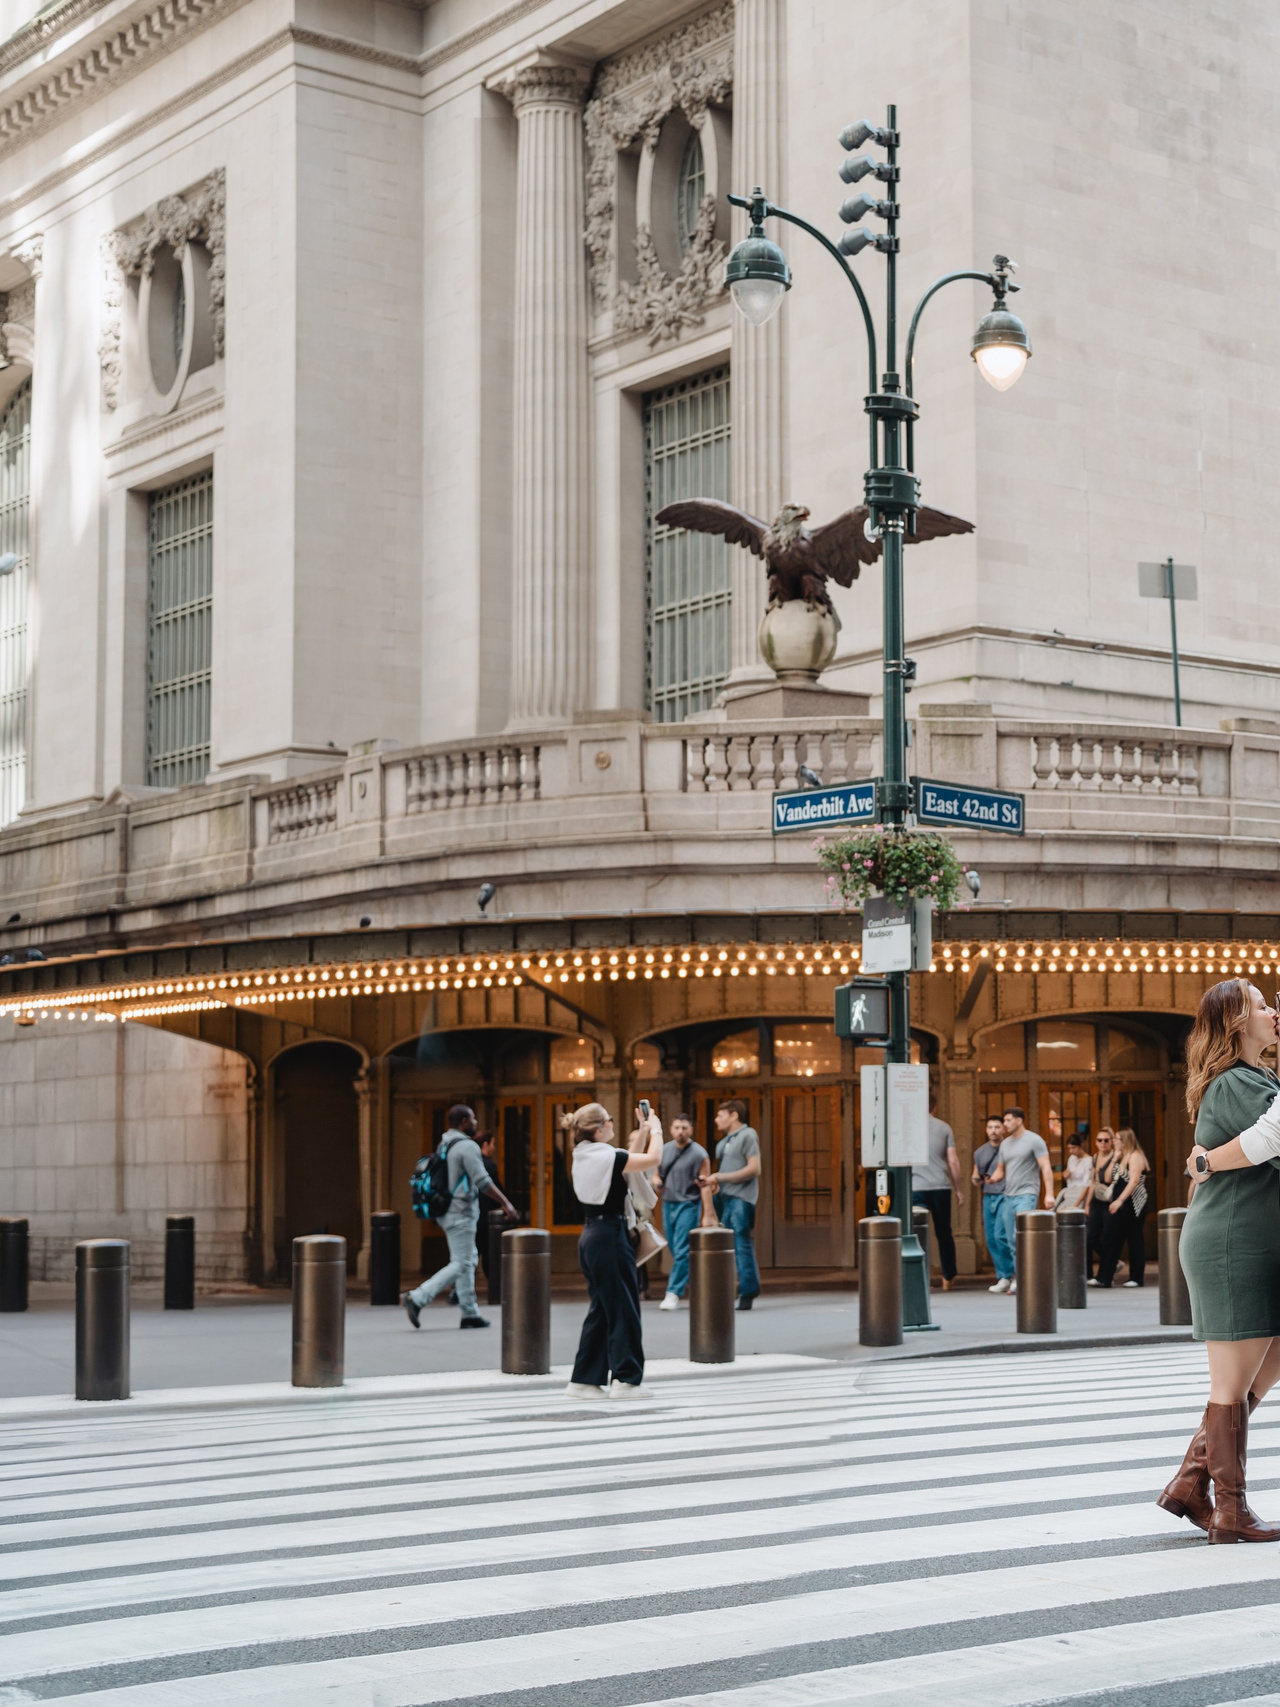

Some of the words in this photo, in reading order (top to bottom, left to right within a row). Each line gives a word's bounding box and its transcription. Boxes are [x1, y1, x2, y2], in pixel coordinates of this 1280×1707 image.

[776, 796, 845, 823] Vanderbilt
[847, 794, 873, 814] Ave
[925, 792, 960, 815] East
[962, 798, 999, 821] 42nd
[1001, 803, 1018, 824] St
[867, 917, 885, 928] Grand
[885, 915, 906, 927] Central
[868, 929, 893, 938] Madison
